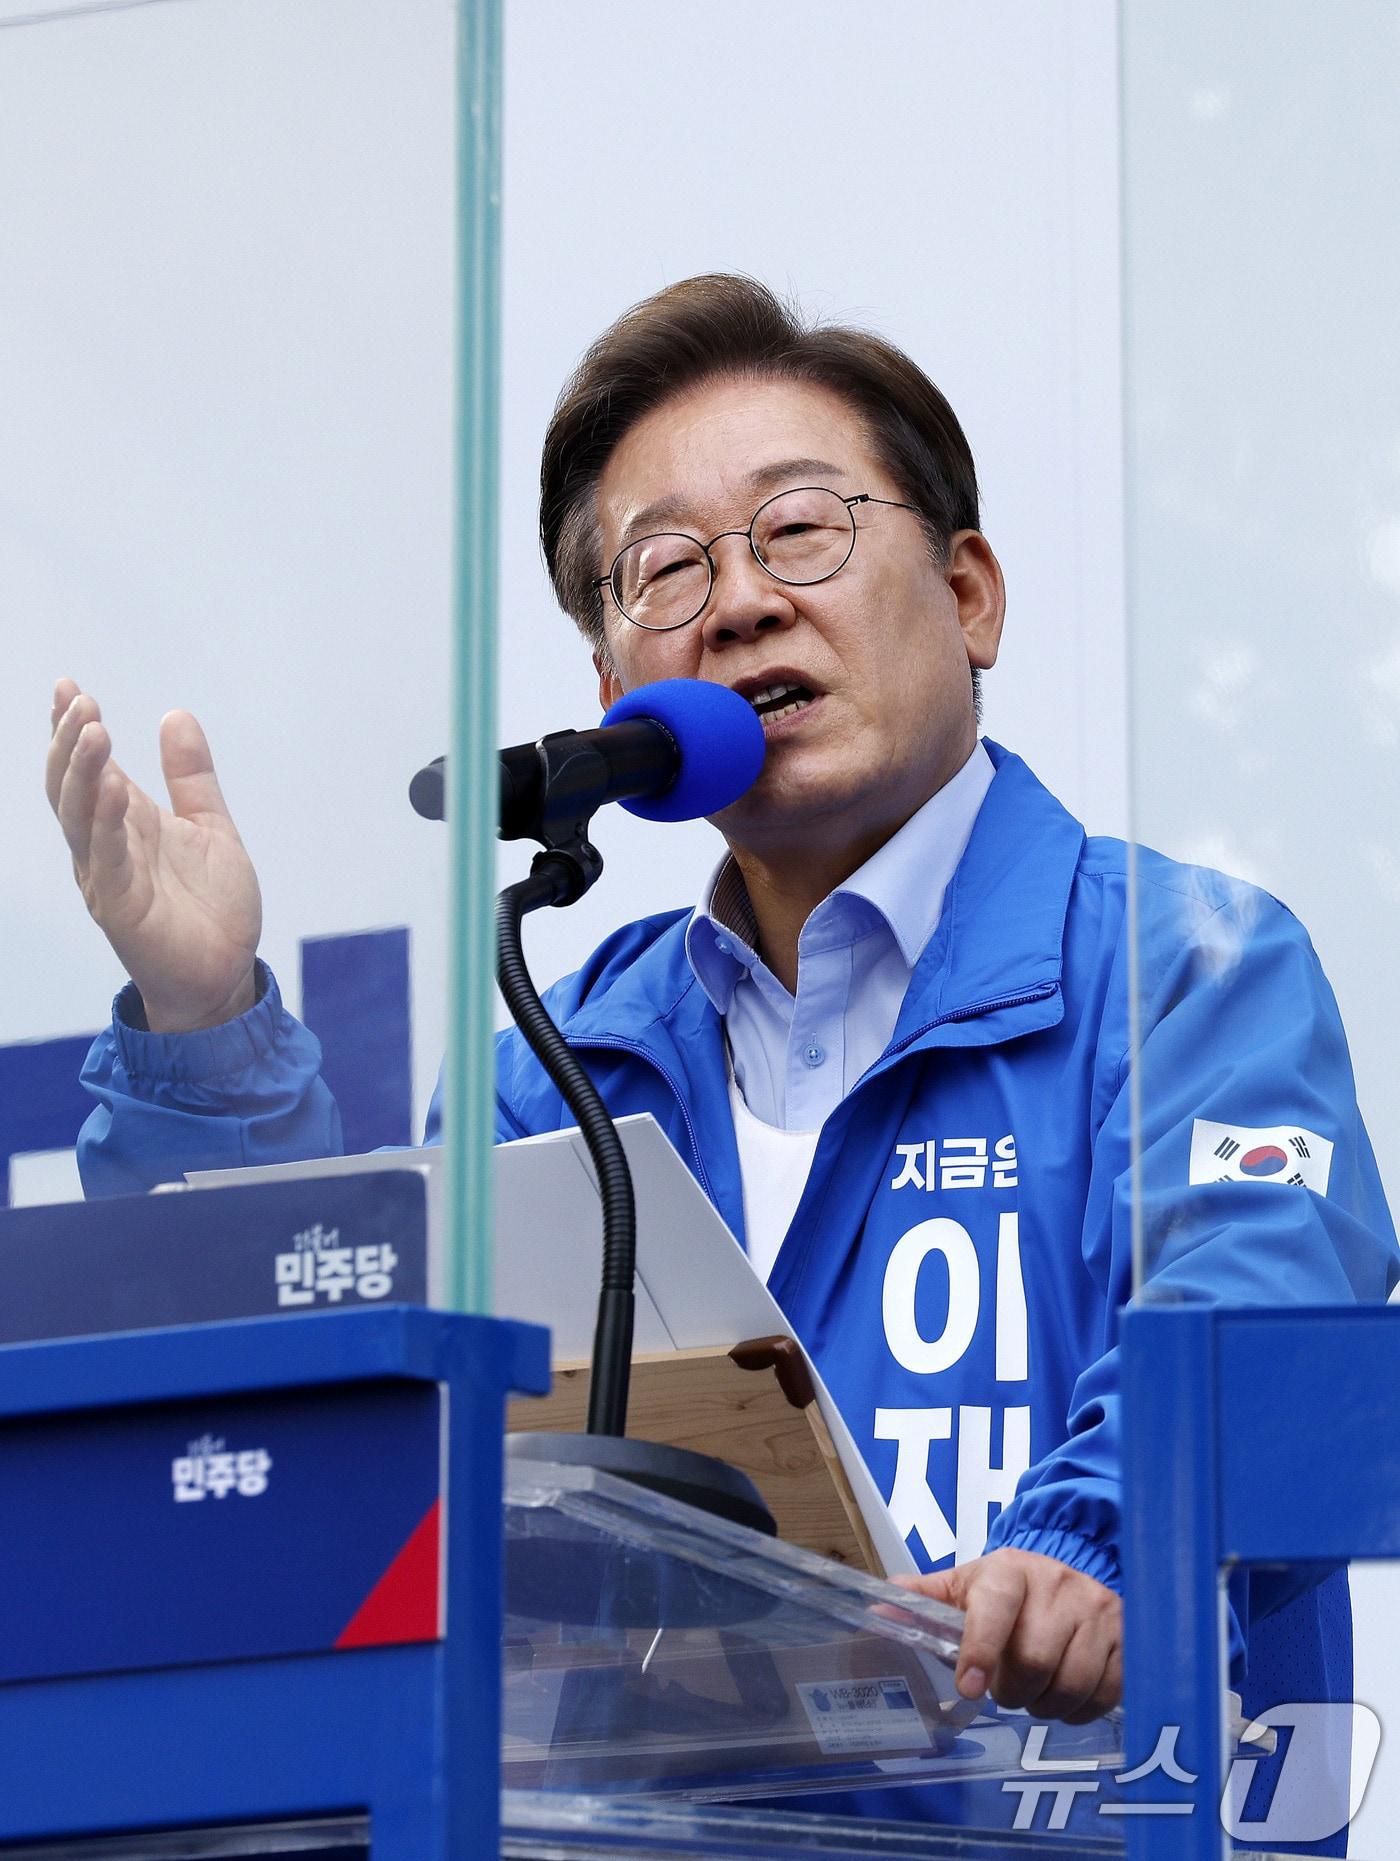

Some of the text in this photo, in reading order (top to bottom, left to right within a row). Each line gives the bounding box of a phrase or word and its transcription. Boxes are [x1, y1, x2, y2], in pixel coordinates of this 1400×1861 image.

[890, 1133, 1020, 1192] 지금은
[274, 1241, 399, 1307] 민주당
[171, 1447, 272, 1503] 민주당
